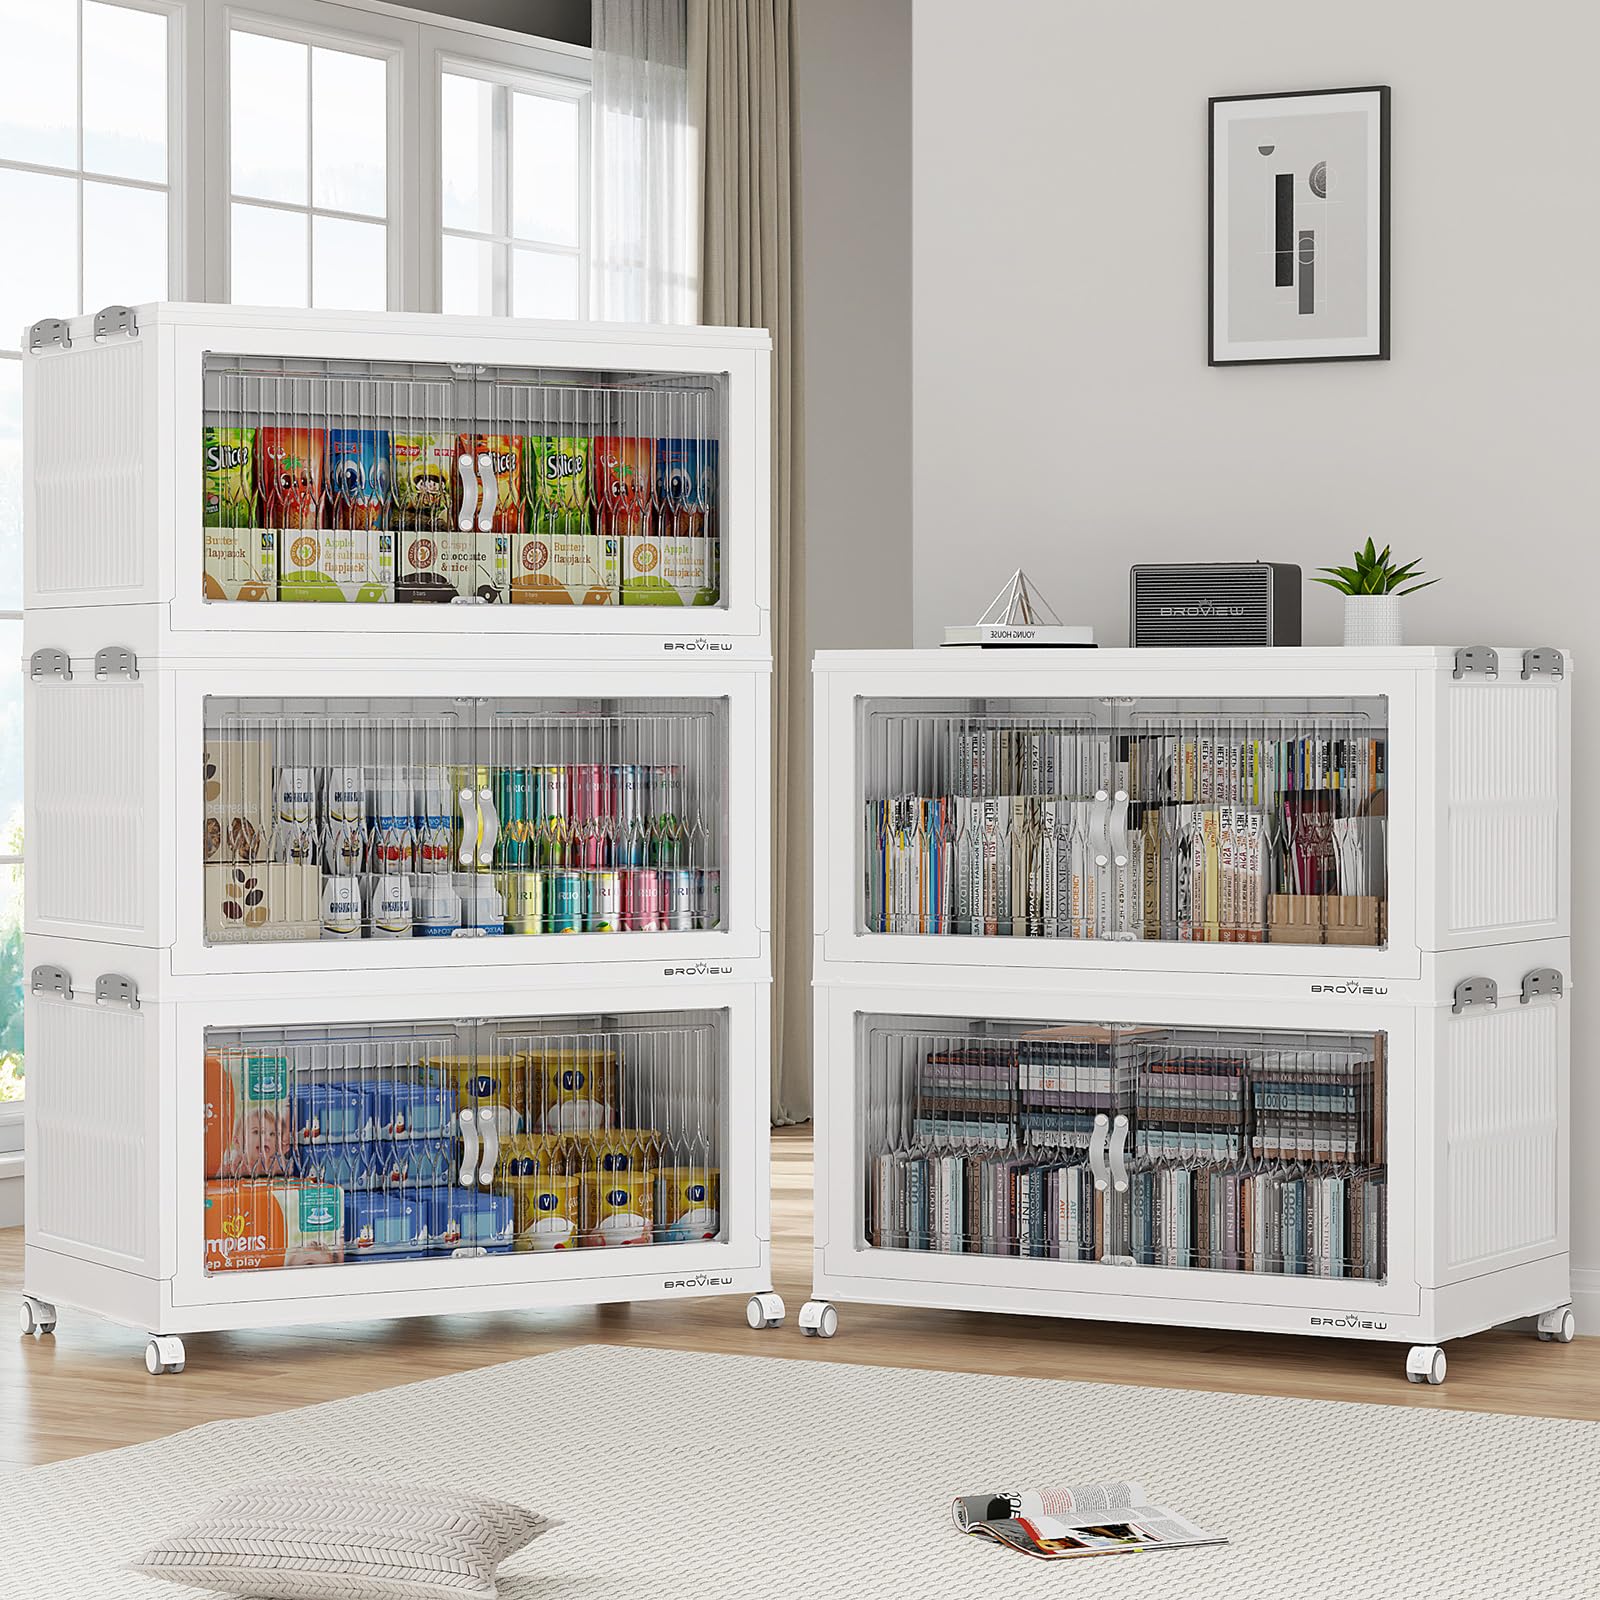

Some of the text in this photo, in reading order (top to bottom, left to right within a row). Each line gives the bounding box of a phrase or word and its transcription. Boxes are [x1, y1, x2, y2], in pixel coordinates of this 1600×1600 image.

[1160, 604, 1244, 616] BROVIEW
[663, 641, 732, 651] BROVIEW
[1146, 852, 1154, 887] BOOK
[251, 926, 306, 940] cereals
[663, 966, 732, 976] BROVIEW
[1311, 984, 1388, 995] BROVIEW
[1030, 1172, 1039, 1224] WINDOWS
[224, 1258, 232, 1267] &
[236, 1256, 260, 1267] play
[664, 1278, 732, 1288] BROVIEW
[1310, 1317, 1387, 1329] BROVIEW
